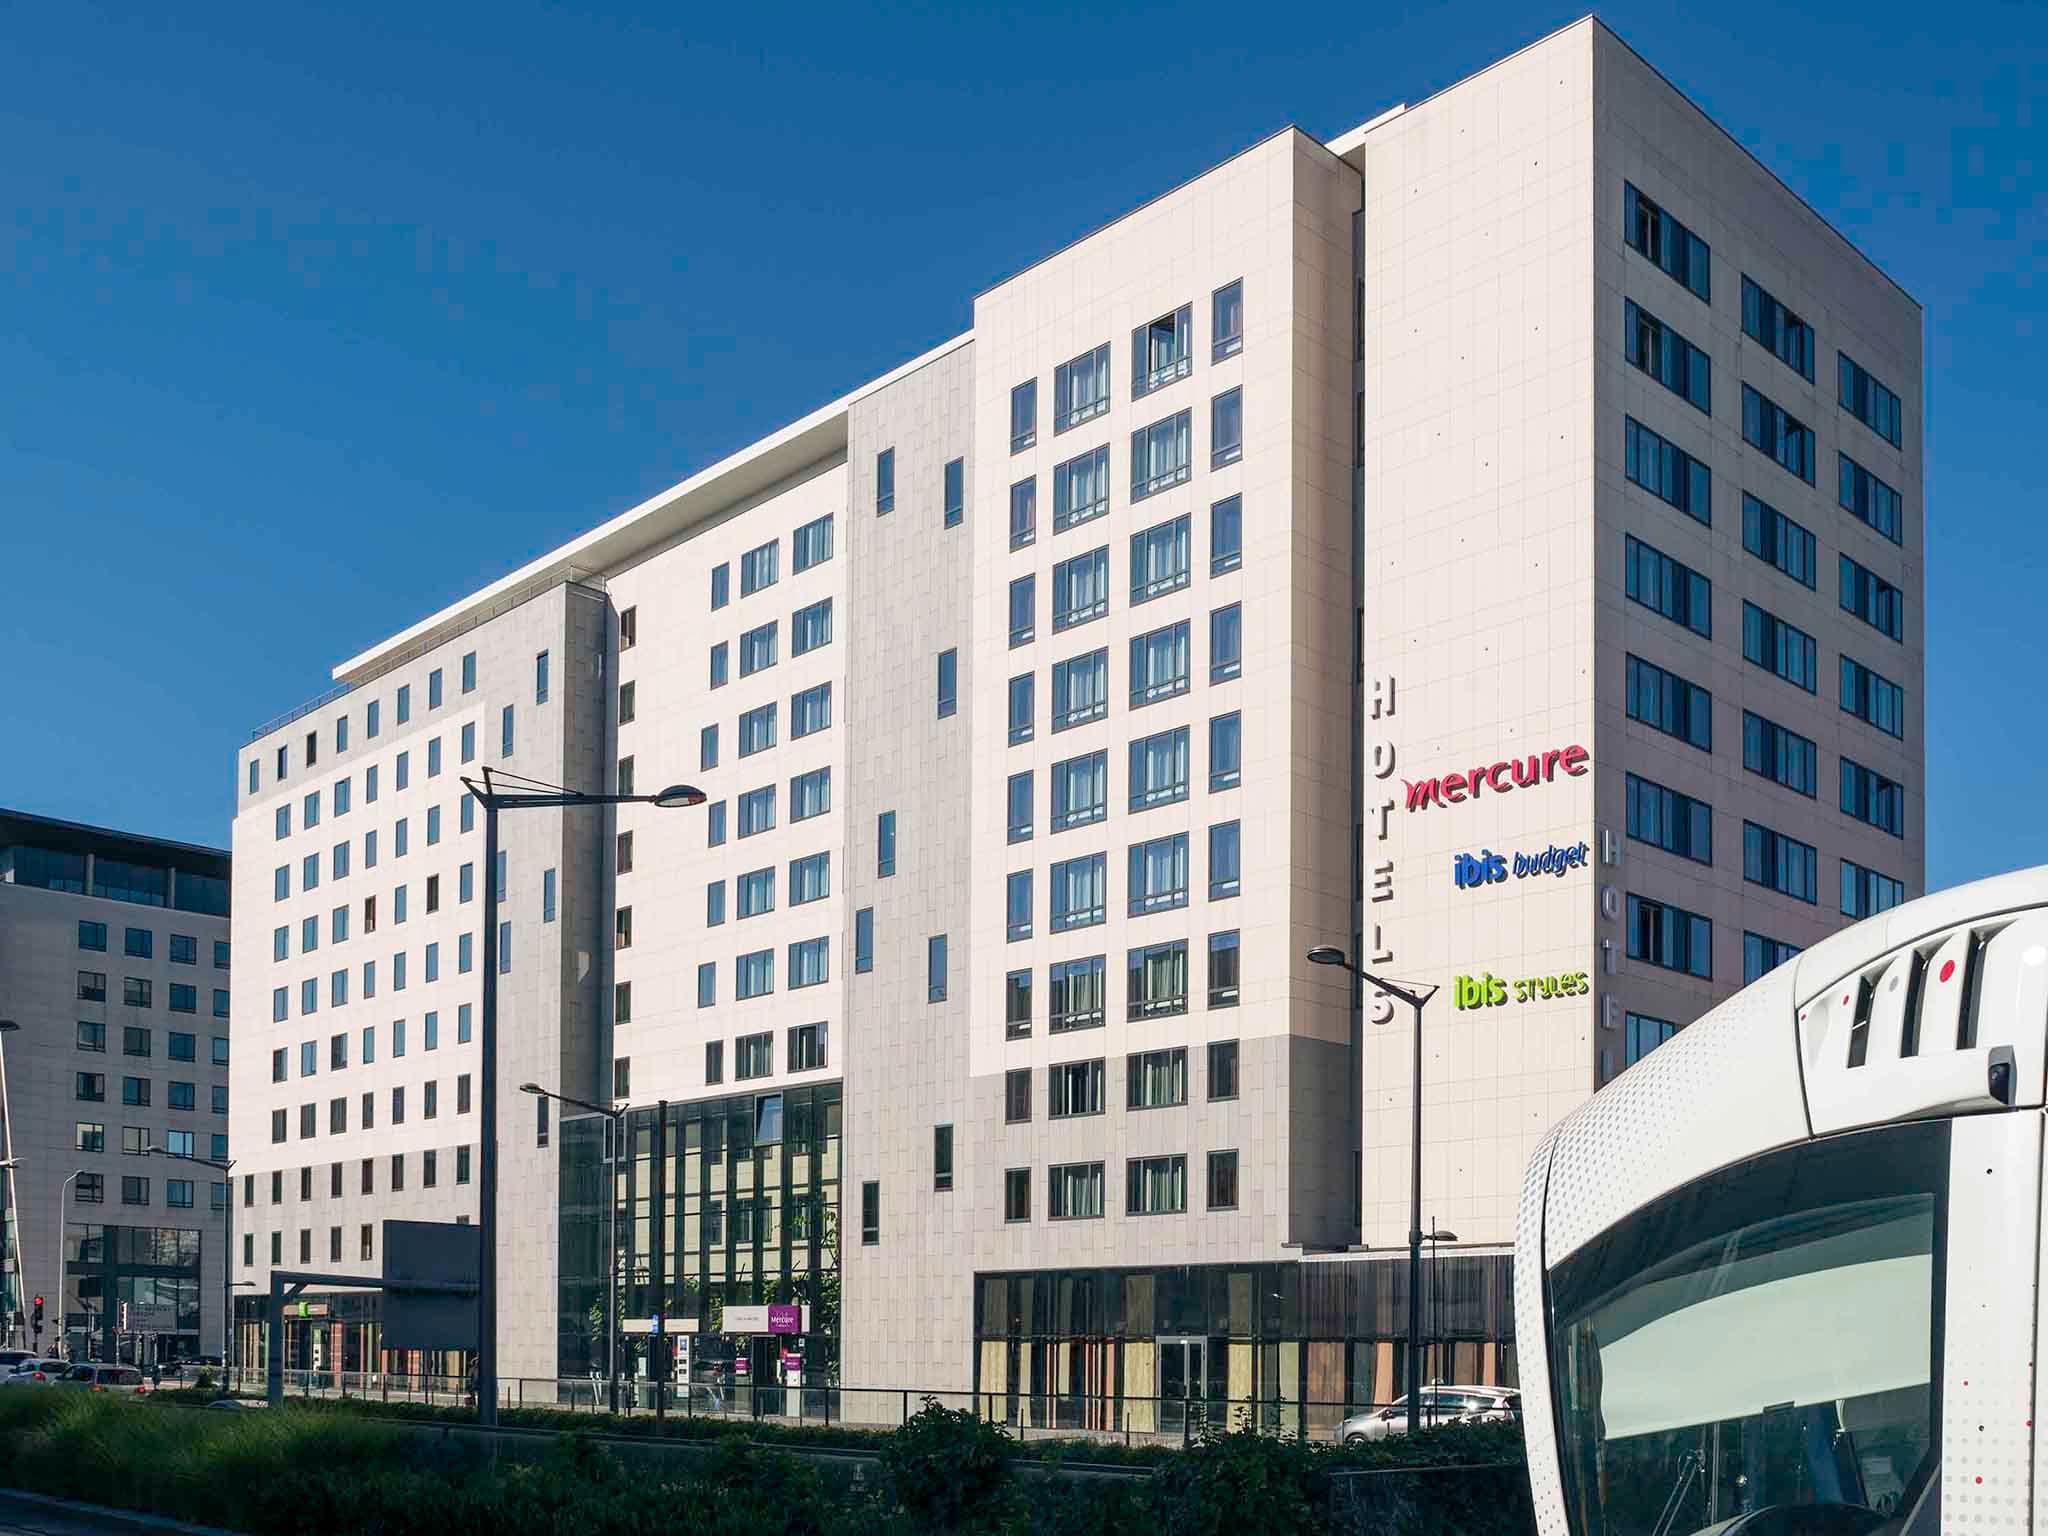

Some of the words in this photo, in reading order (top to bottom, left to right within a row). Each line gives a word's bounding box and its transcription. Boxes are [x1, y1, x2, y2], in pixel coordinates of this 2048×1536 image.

[1370, 674, 1396, 1025] HOTELS
[1454, 849, 1508, 889] ibis
[1513, 841, 1590, 878] budget
[1453, 971, 1508, 1011] ibis
